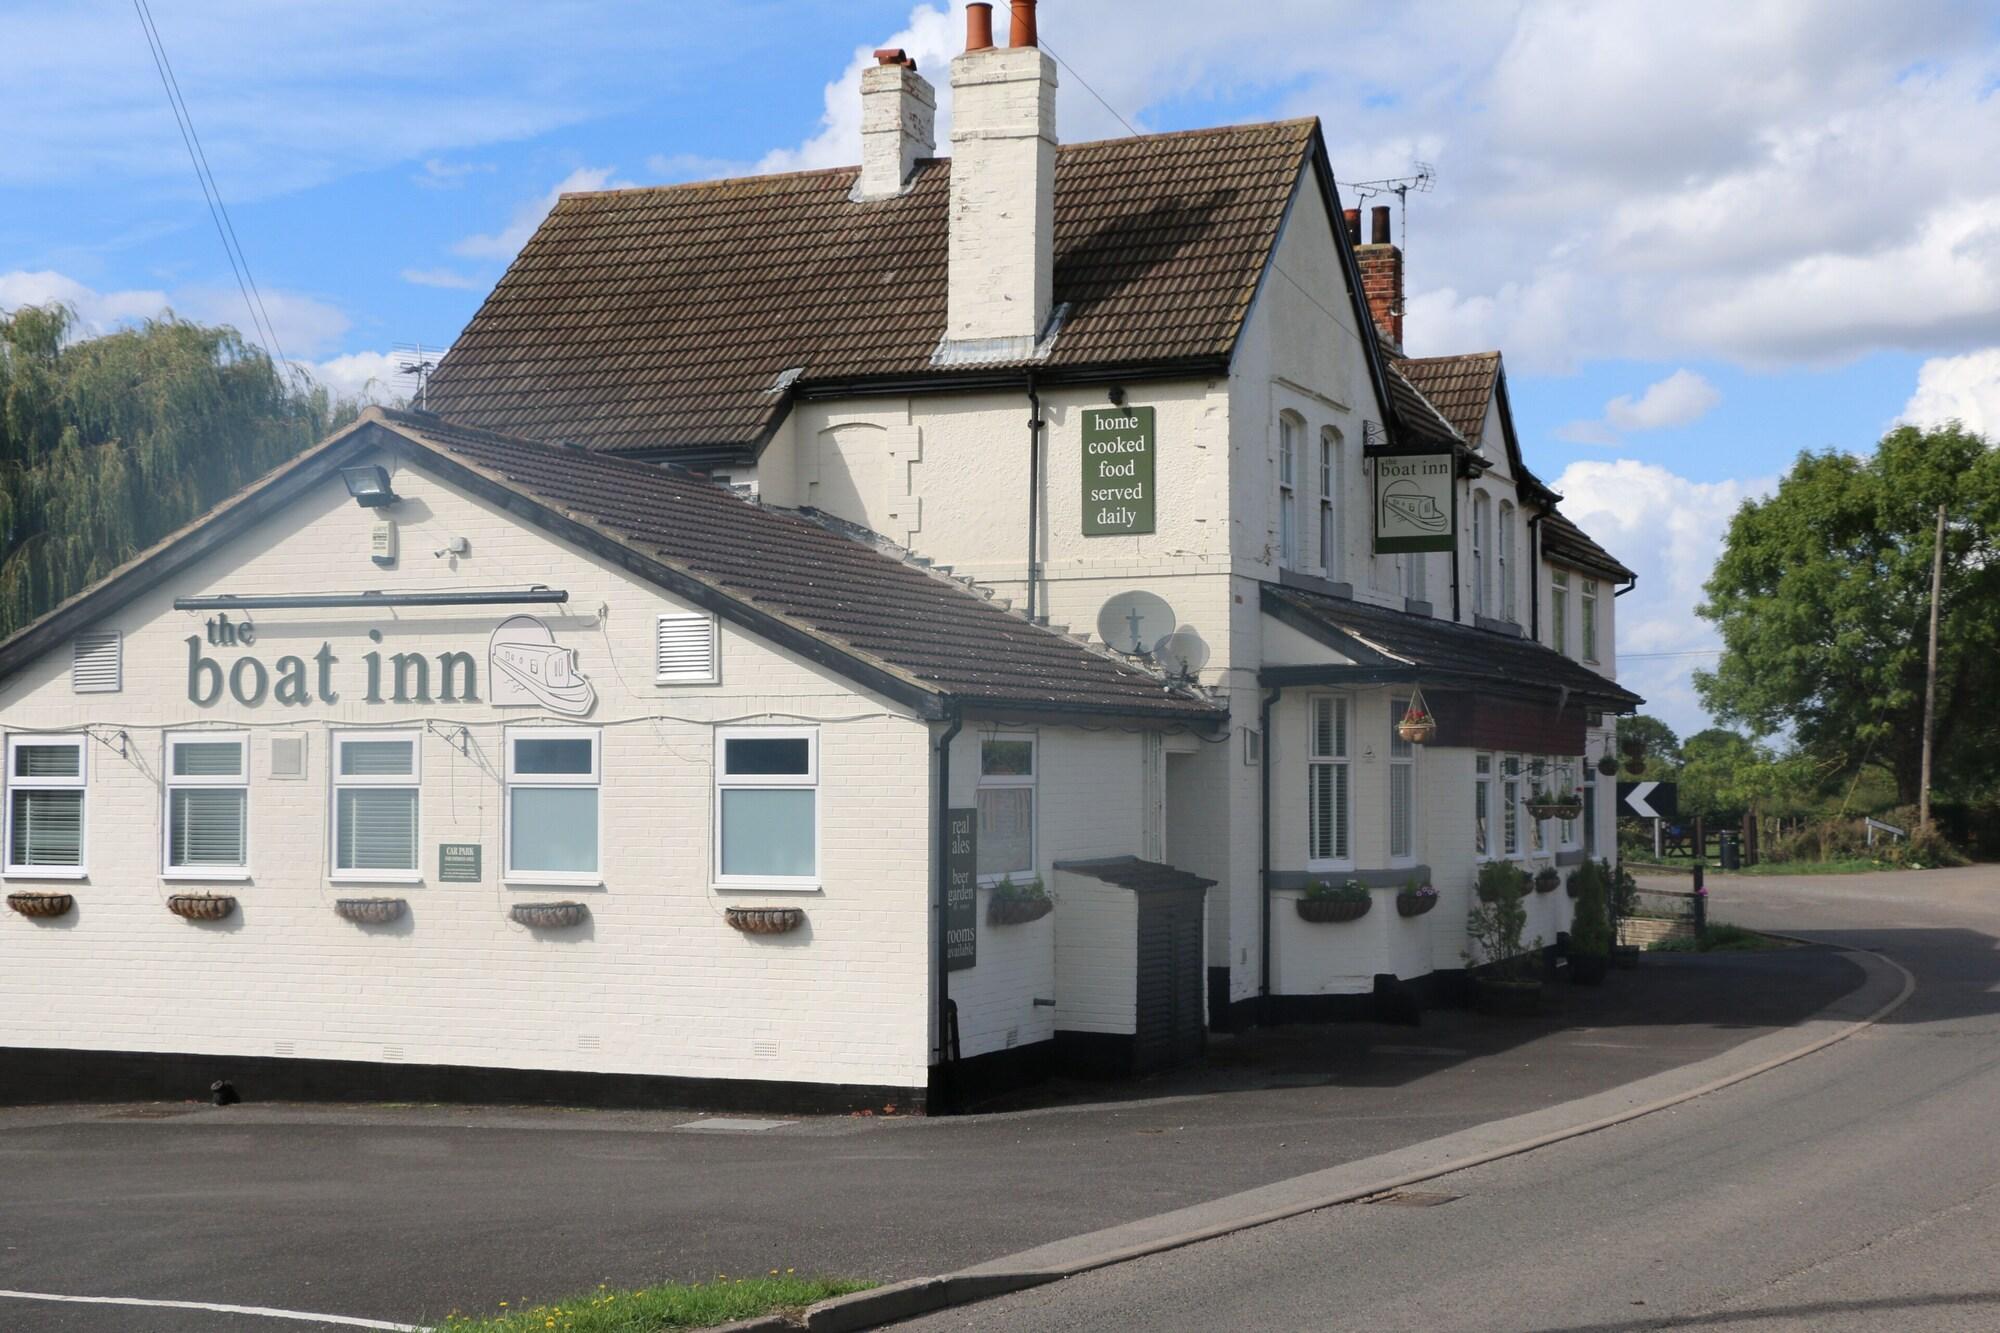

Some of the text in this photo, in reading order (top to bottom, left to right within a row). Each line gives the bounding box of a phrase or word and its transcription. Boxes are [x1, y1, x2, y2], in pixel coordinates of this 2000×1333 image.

[1095, 414, 1139, 431] home
[1088, 435, 1145, 455] cooked
[1099, 459, 1135, 478] food
[1381, 460, 1449, 477] boat inn
[1091, 482, 1143, 502] served
[1097, 507, 1137, 528] daily
[205, 612, 254, 645] the
[184, 628, 480, 706] boat inn
[952, 815, 970, 834] real
[446, 847, 474, 856] CAR PARK
[952, 834, 970, 855] ales
[952, 868, 969, 885] beer
[948, 884, 973, 906] garden
[947, 928, 975, 944] rooms
